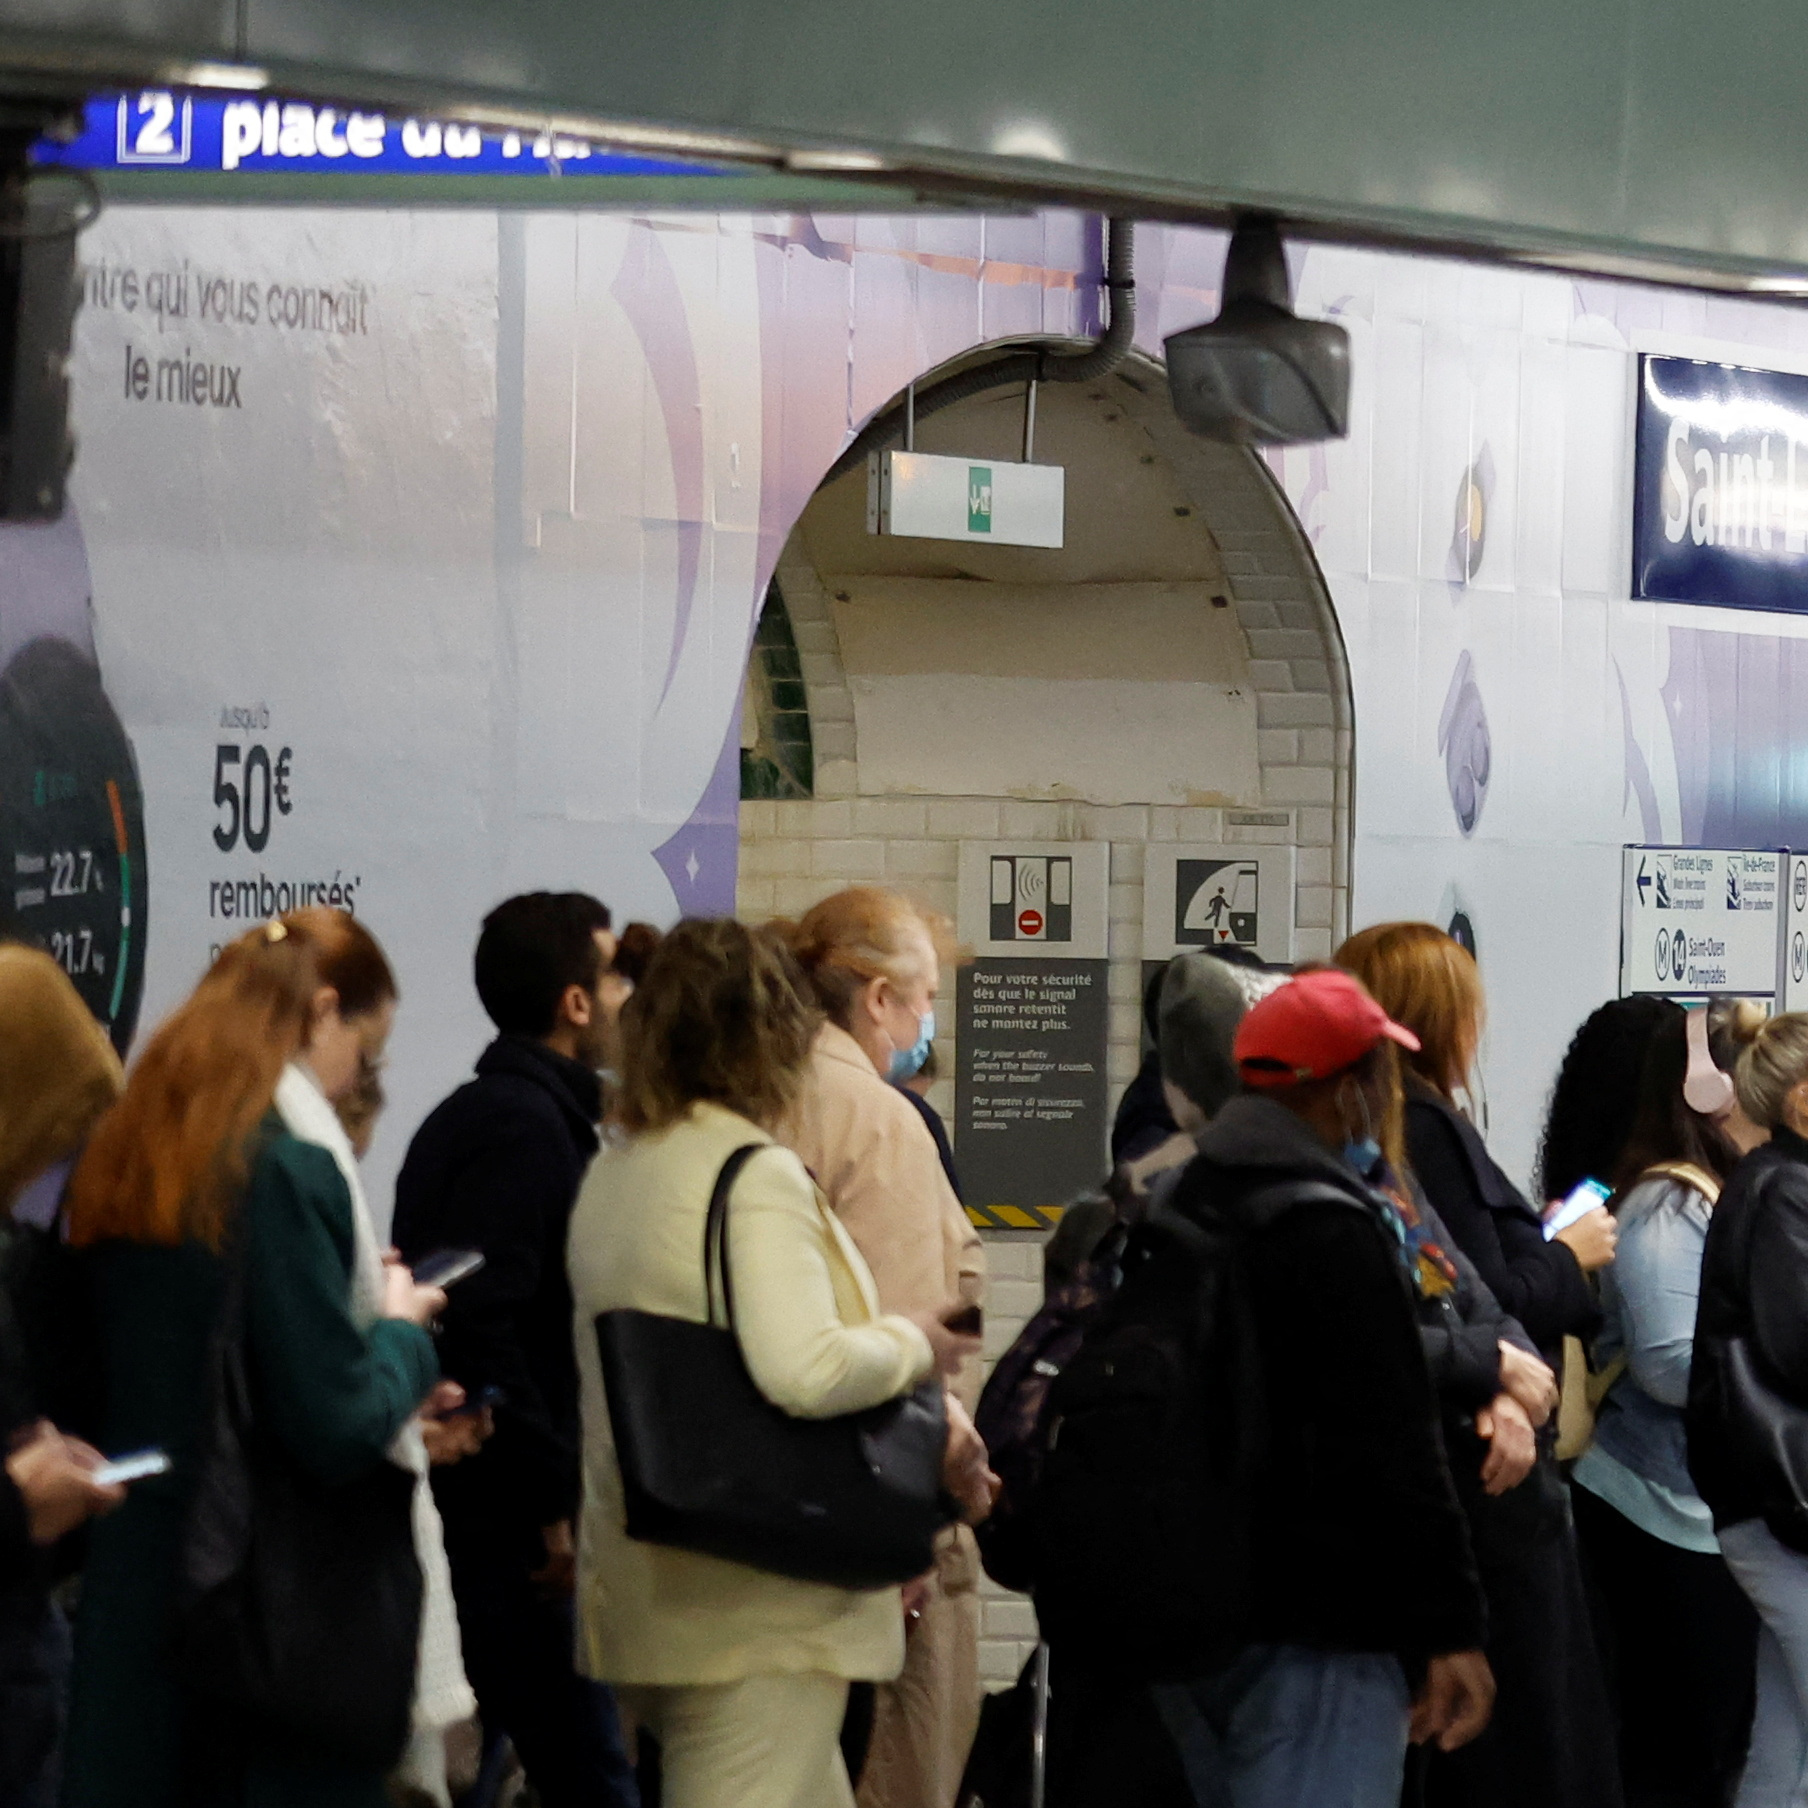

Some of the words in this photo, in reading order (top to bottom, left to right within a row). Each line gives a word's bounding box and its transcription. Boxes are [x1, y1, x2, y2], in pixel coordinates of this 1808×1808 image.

[136, 91, 175, 153] 2
[222, 101, 387, 170] place
[146, 257, 189, 334] qui
[197, 275, 260, 326] vous
[125, 344, 150, 401] le
[155, 346, 243, 408] mieux
[212, 744, 293, 853] 50€
[973, 971, 1003, 985] Pour
[1005, 974, 1039, 985] votre
[1041, 973, 1093, 986] sécurité
[998, 989, 1022, 1001] que
[1024, 987, 1037, 1000] le
[1039, 987, 1077, 1002] signal
[972, 1019, 990, 1029] ne
